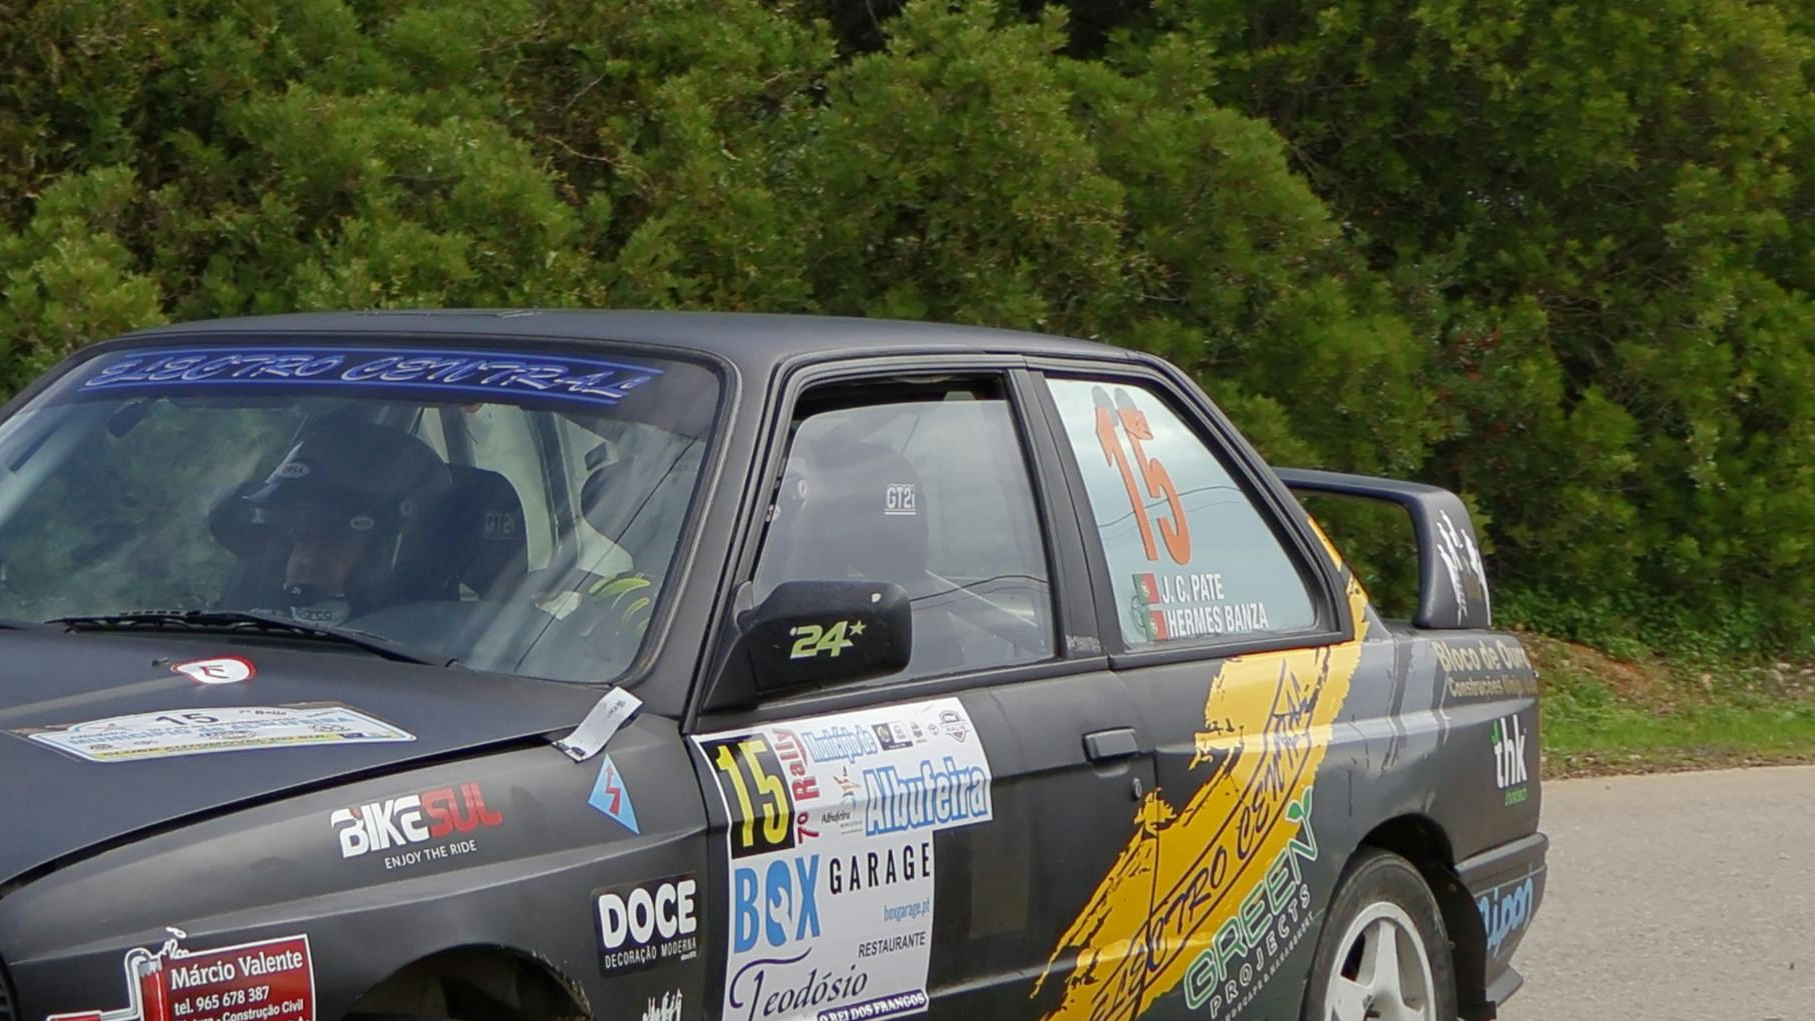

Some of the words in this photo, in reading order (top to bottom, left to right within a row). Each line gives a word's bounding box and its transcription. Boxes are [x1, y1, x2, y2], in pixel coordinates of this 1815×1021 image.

[85, 354, 346, 387] ELECTRO
[340, 356, 651, 398] CENTRAL
[1095, 405, 1192, 565] 15
[1190, 573, 1225, 601] PATE
[1167, 605, 1223, 638] HERMES
[1223, 602, 1270, 632] BANZA
[1431, 640, 1481, 672] Bloco
[1479, 639, 1501, 670] de
[156, 712, 220, 726] 15
[773, 728, 821, 802] Rally
[715, 739, 790, 848] 15
[864, 756, 990, 838] Albufeira
[385, 851, 424, 870] ENJOY
[423, 845, 449, 861] THE
[449, 840, 477, 857] RIDE
[598, 879, 698, 949] DOCE
[733, 854, 821, 954] BOX
[829, 842, 931, 895] GARAGE
[1184, 785, 1319, 1010] GREEN
[604, 943, 658, 969] DECORAÇÃO
[660, 937, 698, 958] MODERNA
[858, 931, 927, 959] RESTAURANTE
[1210, 883, 1311, 1020] PROJECTS
[170, 959, 235, 991] Márcio
[237, 948, 304, 978] Valente
[174, 997, 194, 1017] tel.
[195, 993, 220, 1013] 965
[222, 989, 245, 1009] 678
[247, 985, 271, 1004] 387
[281, 998, 305, 1014] Civil
[850, 1003, 874, 1020] DOS
[873, 992, 926, 1015] FRANGOS
